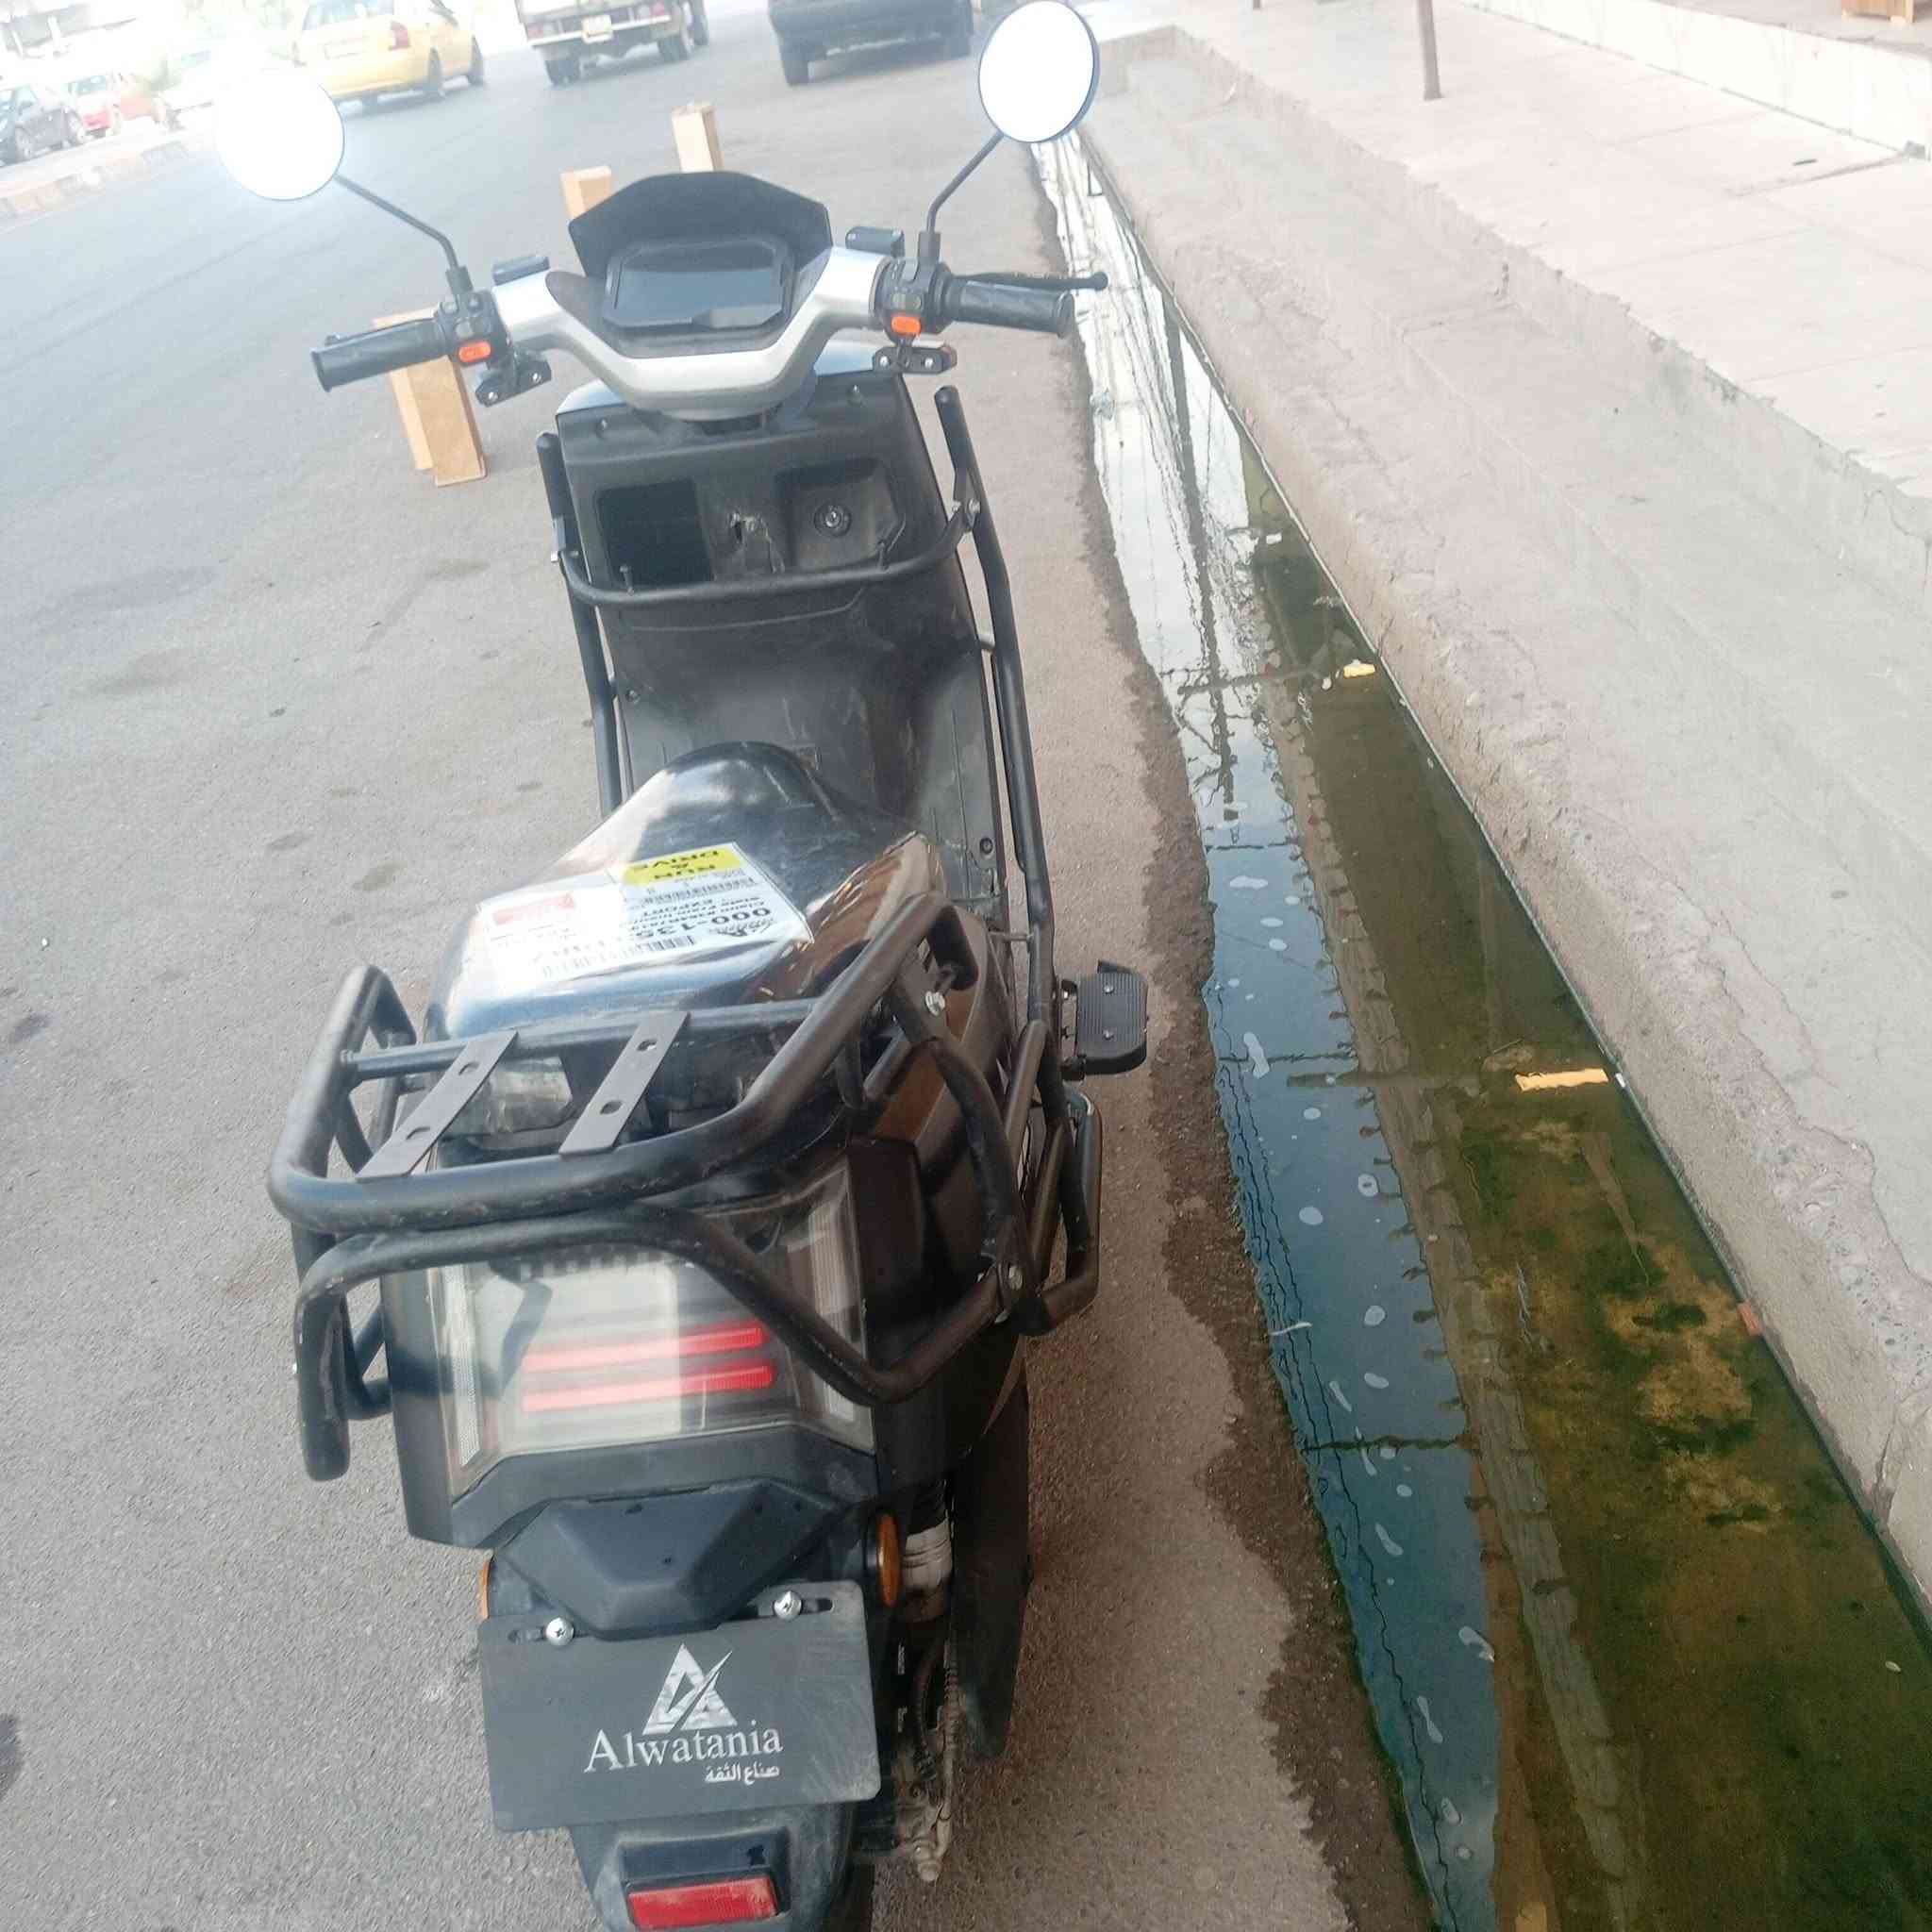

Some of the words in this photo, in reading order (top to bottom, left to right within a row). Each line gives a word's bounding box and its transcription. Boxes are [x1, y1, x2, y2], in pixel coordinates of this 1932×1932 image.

[583, 1720, 784, 1774] Alwatania
[705, 1762, 741, 1783] الثقة
[743, 1761, 780, 1785] صناع
